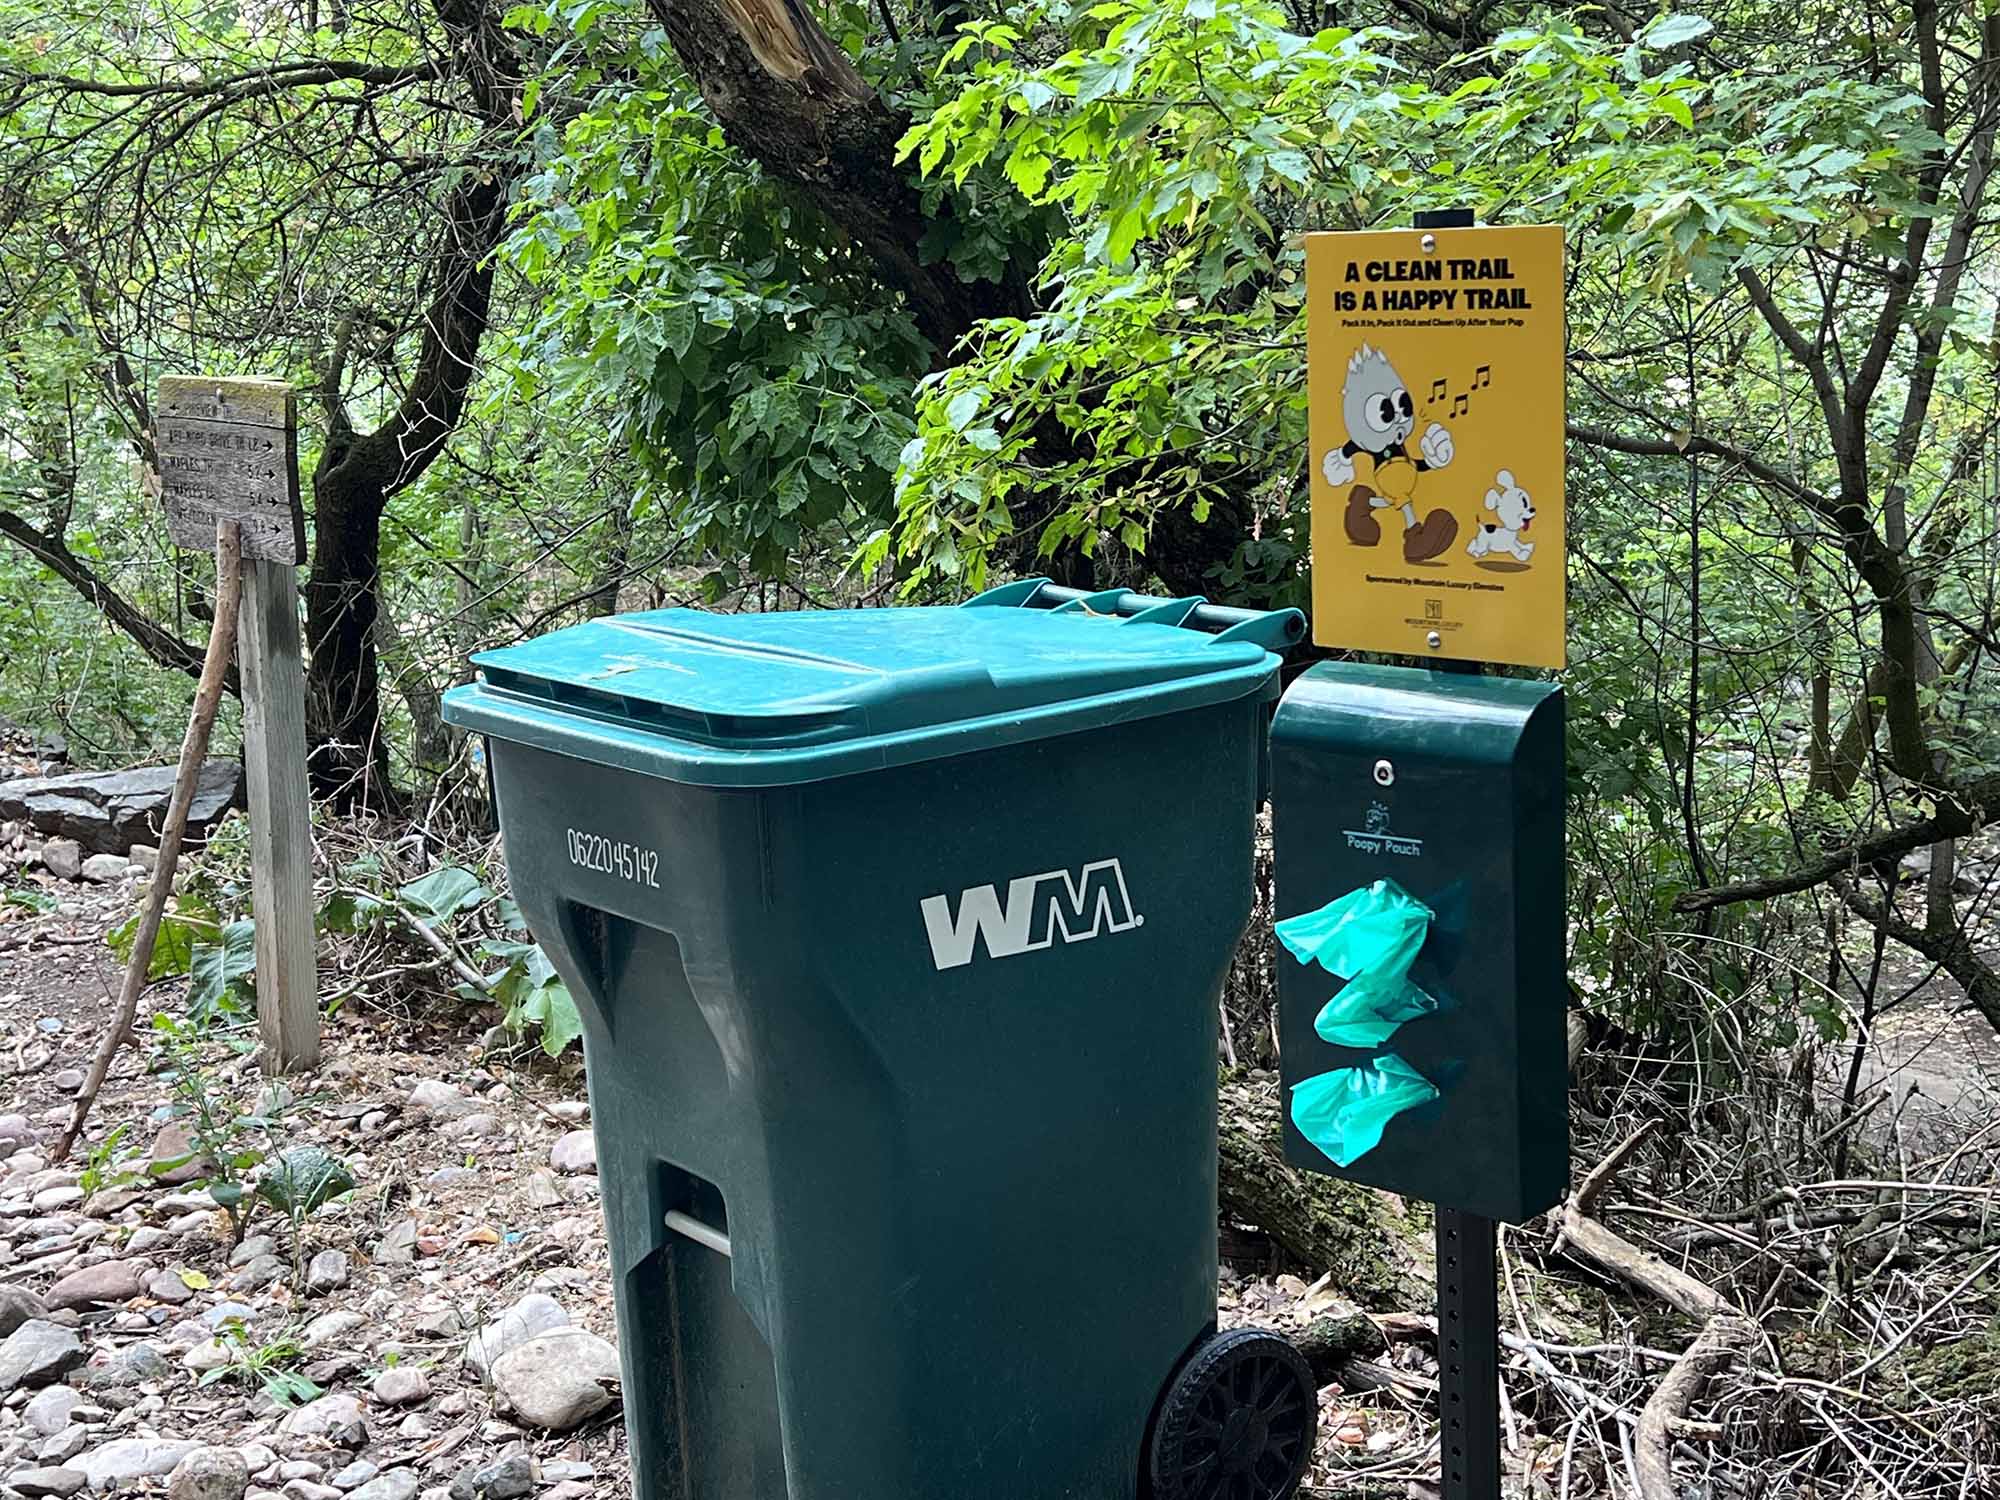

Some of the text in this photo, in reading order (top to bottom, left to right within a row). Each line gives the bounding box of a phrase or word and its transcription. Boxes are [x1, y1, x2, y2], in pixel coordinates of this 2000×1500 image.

[1344, 258, 1515, 283] A CLEAN TRAIL
[1334, 288, 1532, 312] IS A HAPPY TRAIL
[1455, 318, 1466, 328] Up
[1467, 318, 1488, 327] After
[1507, 317, 1525, 328] Pup
[1400, 577, 1412, 586] by
[1412, 577, 1446, 588] Mountain
[1446, 580, 1473, 591] Luxury
[1347, 836, 1420, 856] Poopy Pouch
[567, 828, 661, 889] 0622045142
[920, 857, 1137, 971] WM
